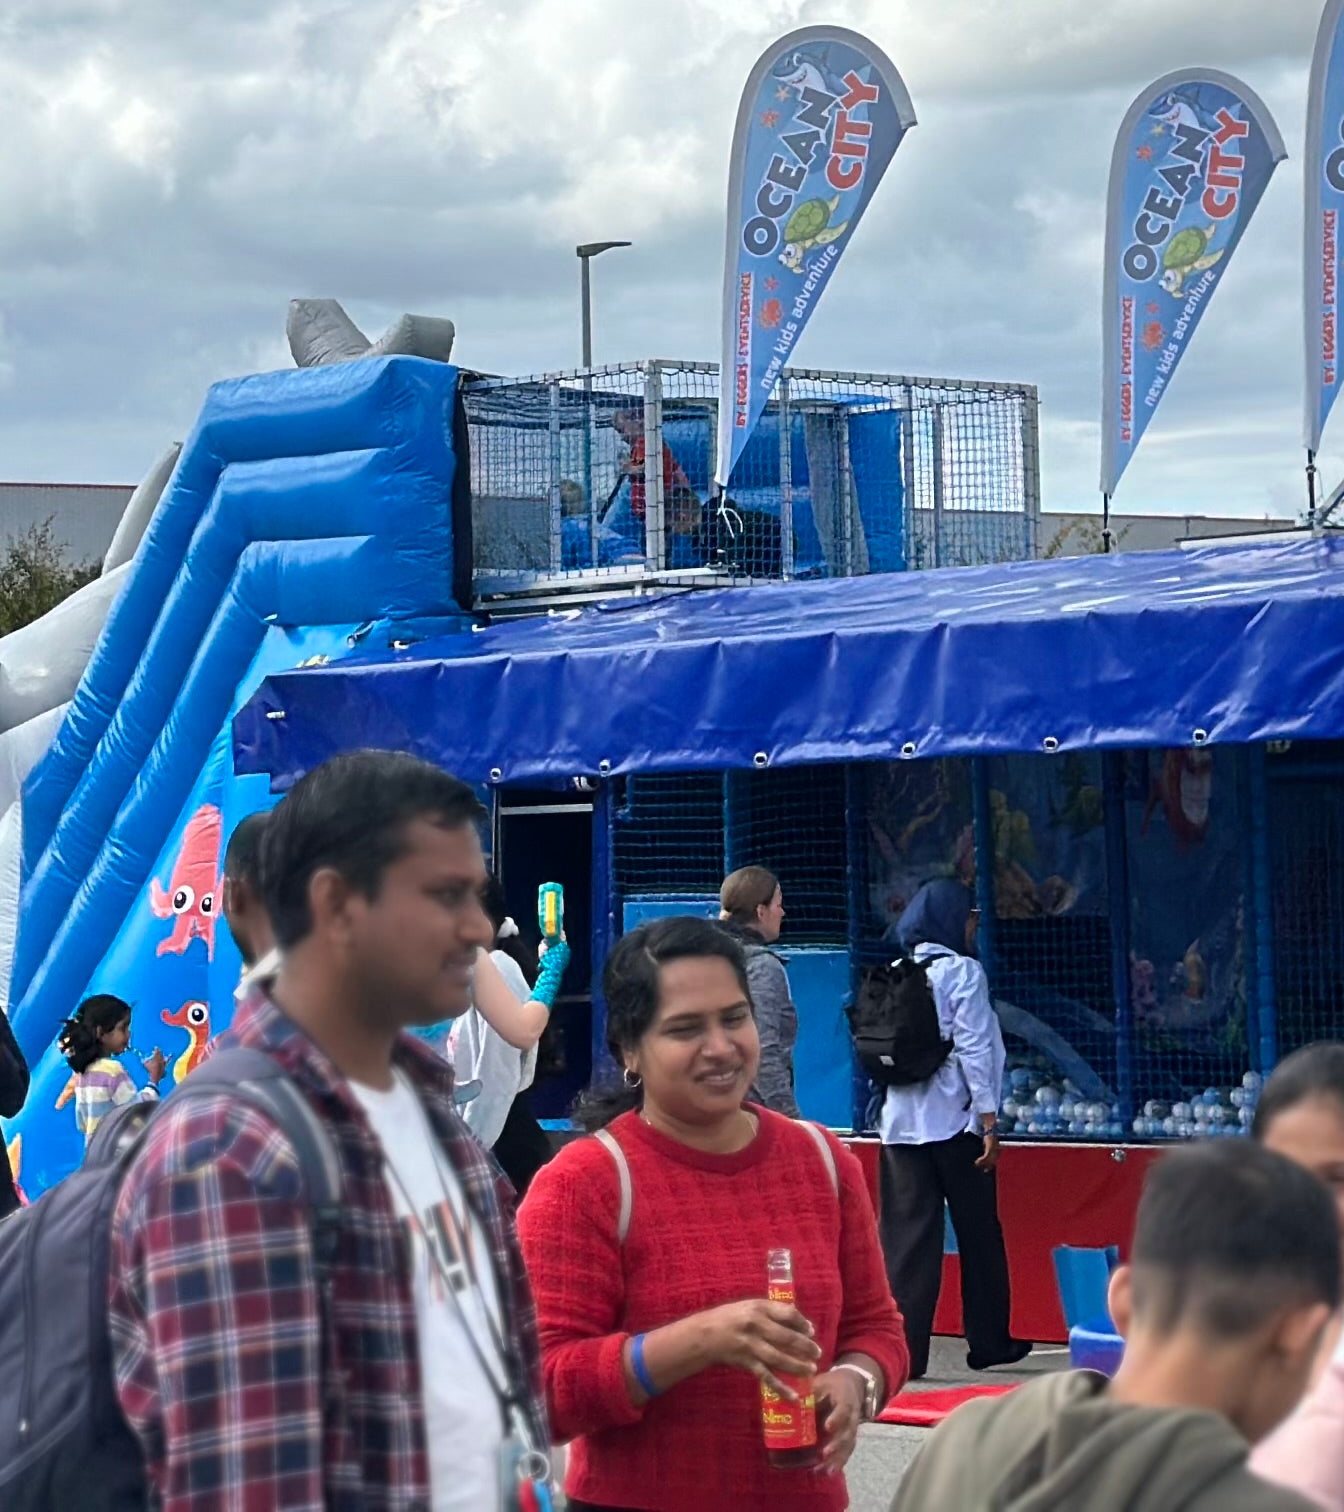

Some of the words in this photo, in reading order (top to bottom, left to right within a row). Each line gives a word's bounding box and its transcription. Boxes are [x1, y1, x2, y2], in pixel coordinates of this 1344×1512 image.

[743, 86, 840, 256] OCEAN
[825, 69, 879, 191] CITY
[1201, 107, 1249, 220] CITY
[1122, 122, 1210, 283] OCEAN
[760, 355, 782, 390] new
[774, 321, 798, 354] kids
[792, 243, 838, 319] adventure
[1144, 375, 1165, 407] new
[1157, 342, 1179, 374] kids
[1172, 269, 1216, 340] adventure
